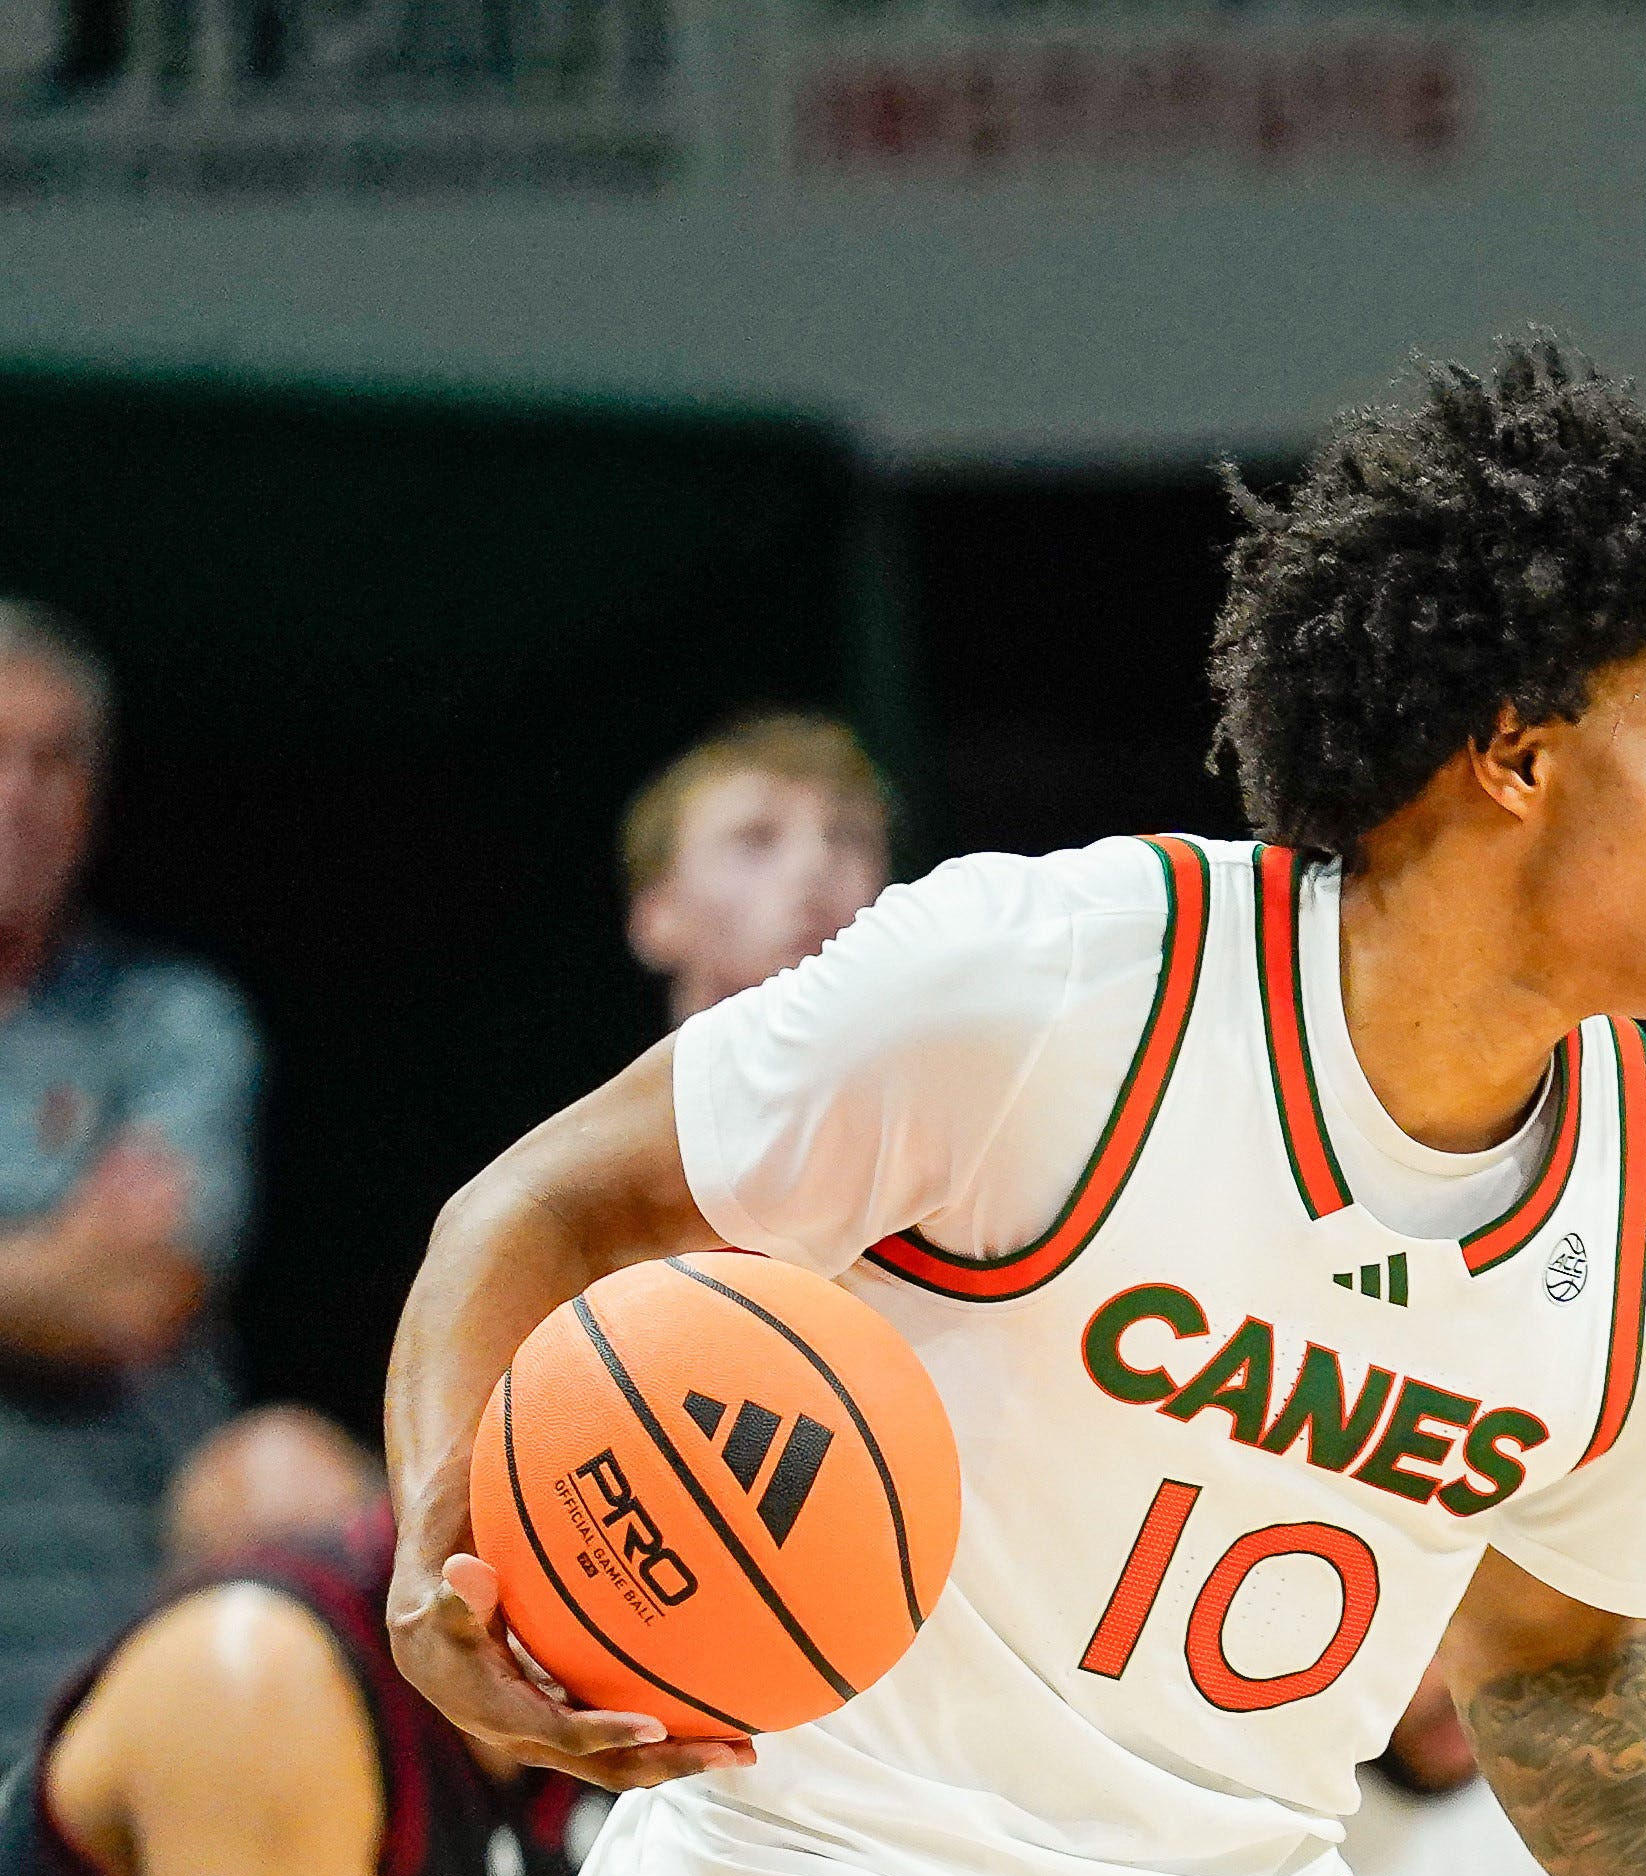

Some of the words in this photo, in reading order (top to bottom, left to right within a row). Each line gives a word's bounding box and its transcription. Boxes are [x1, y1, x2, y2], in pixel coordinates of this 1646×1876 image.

[1081, 1282, 1550, 1517] CANES
[555, 1478, 594, 1545] OFFICIAL
[593, 1547, 628, 1591] GAME
[623, 1589, 657, 1627] BALL
[575, 1446, 698, 1607] PRO
[1078, 1478, 1380, 1713] 10
